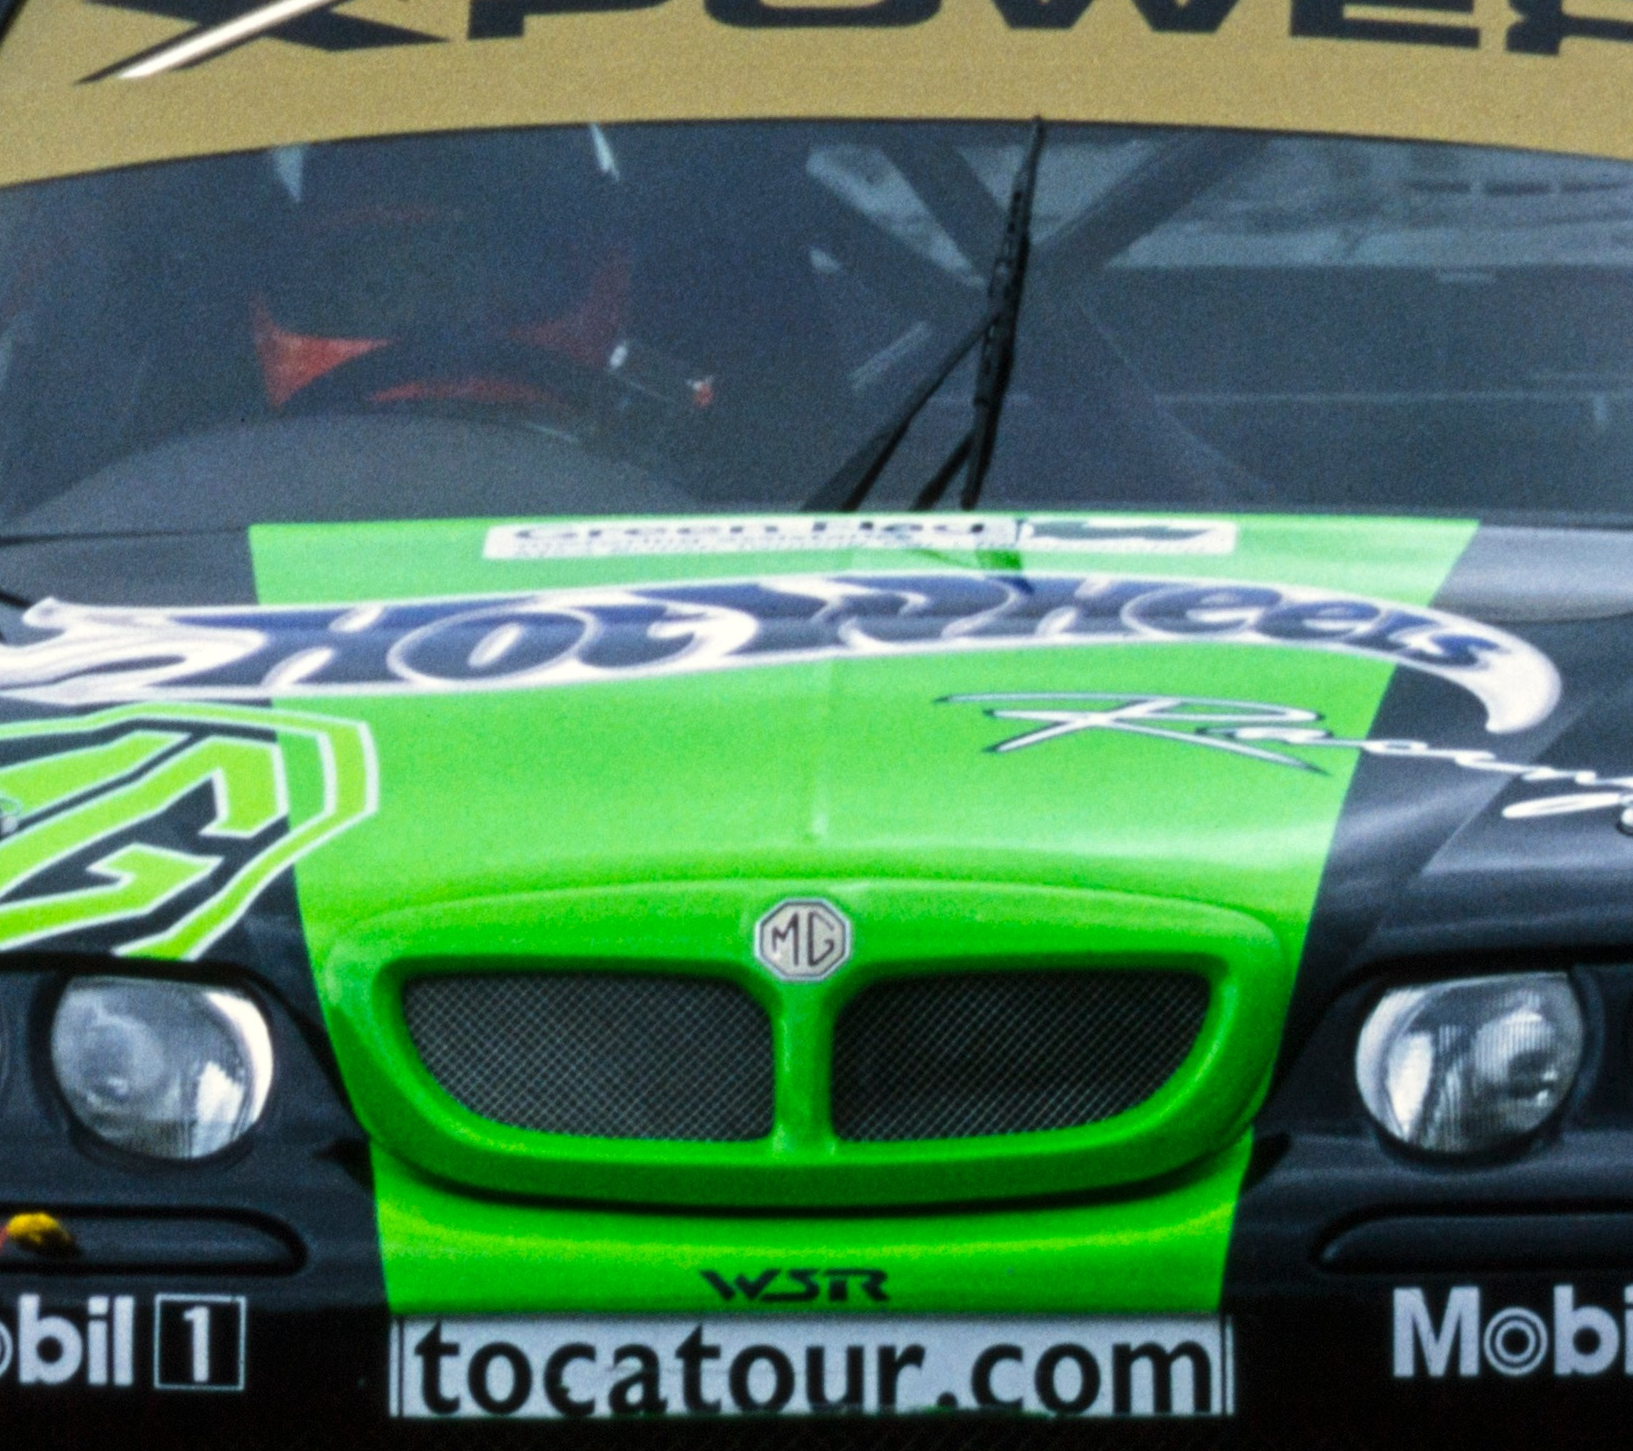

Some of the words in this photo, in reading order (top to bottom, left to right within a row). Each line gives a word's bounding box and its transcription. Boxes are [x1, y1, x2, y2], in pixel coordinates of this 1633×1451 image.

[769, 912, 837, 969] MG
[699, 1266, 891, 1302] WSR
[412, 1322, 1214, 1416] tocatour.com
